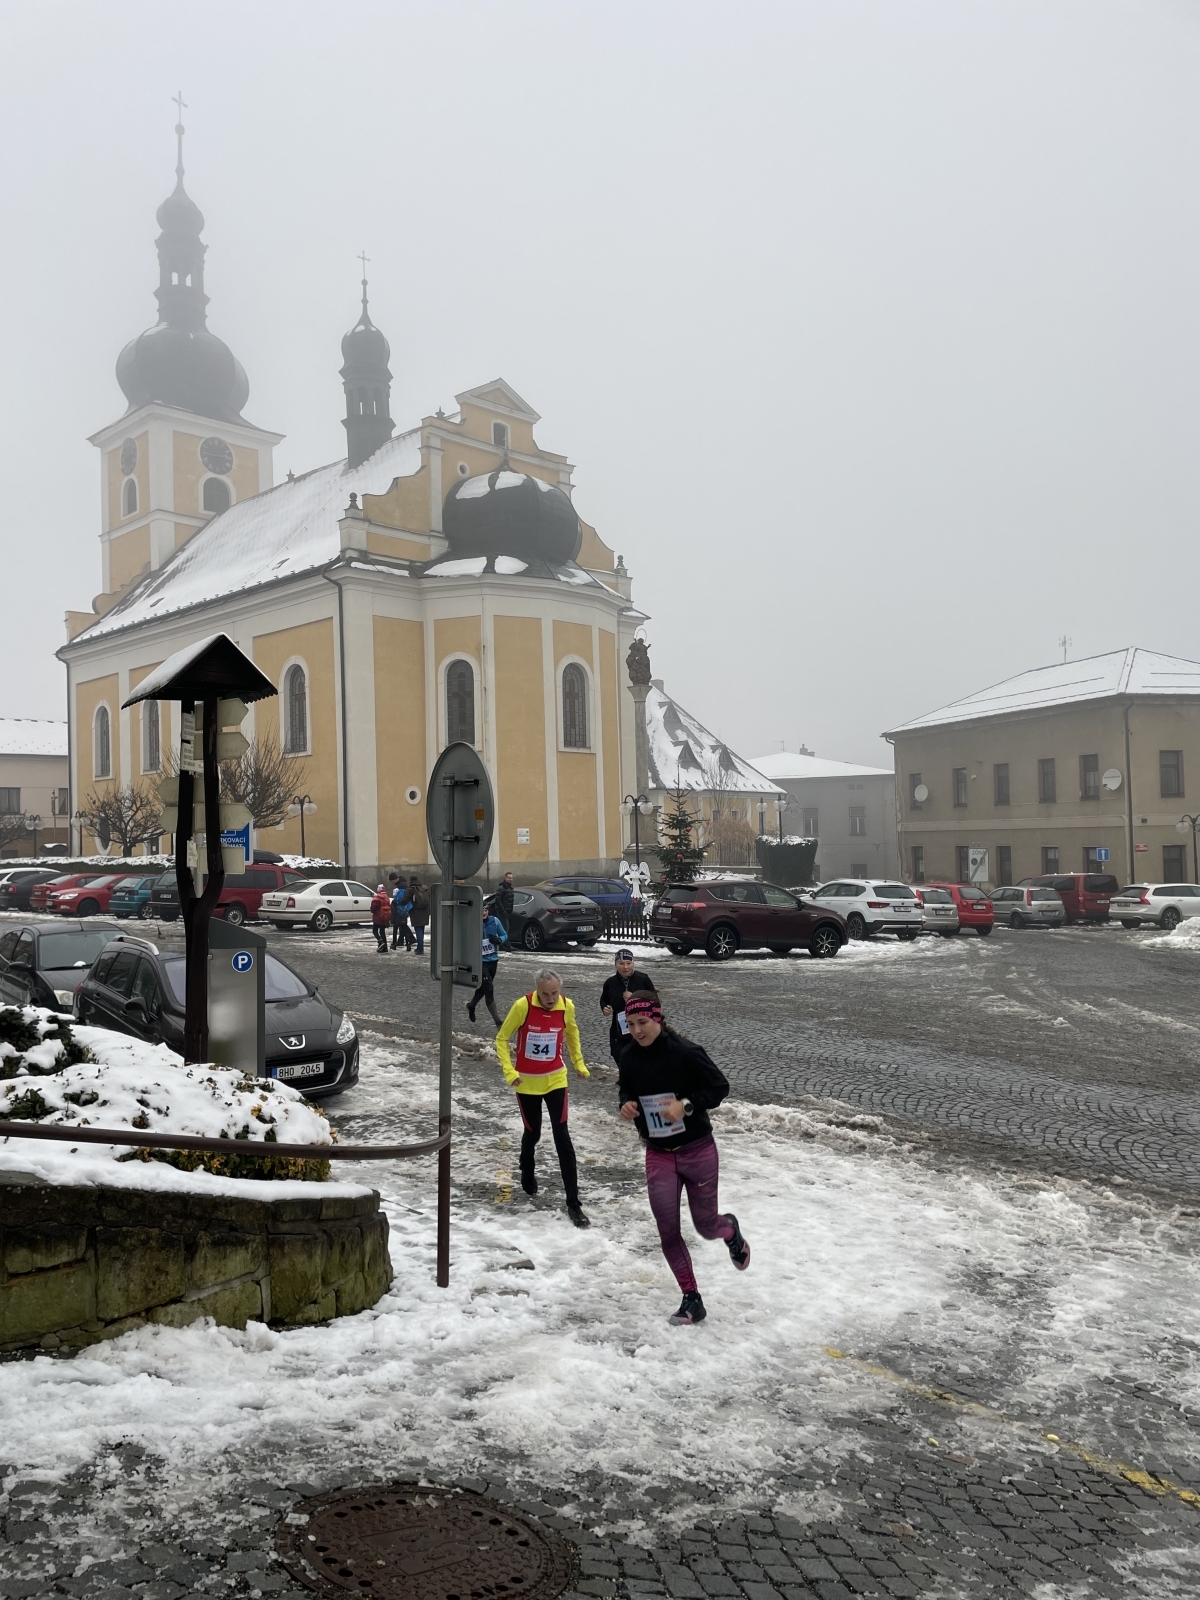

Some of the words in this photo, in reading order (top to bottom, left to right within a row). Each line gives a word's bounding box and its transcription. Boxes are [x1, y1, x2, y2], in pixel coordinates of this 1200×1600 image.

[532, 1043, 550, 1056] 34
[301, 1063, 321, 1075] 2045
[649, 1112, 673, 1128] 11
